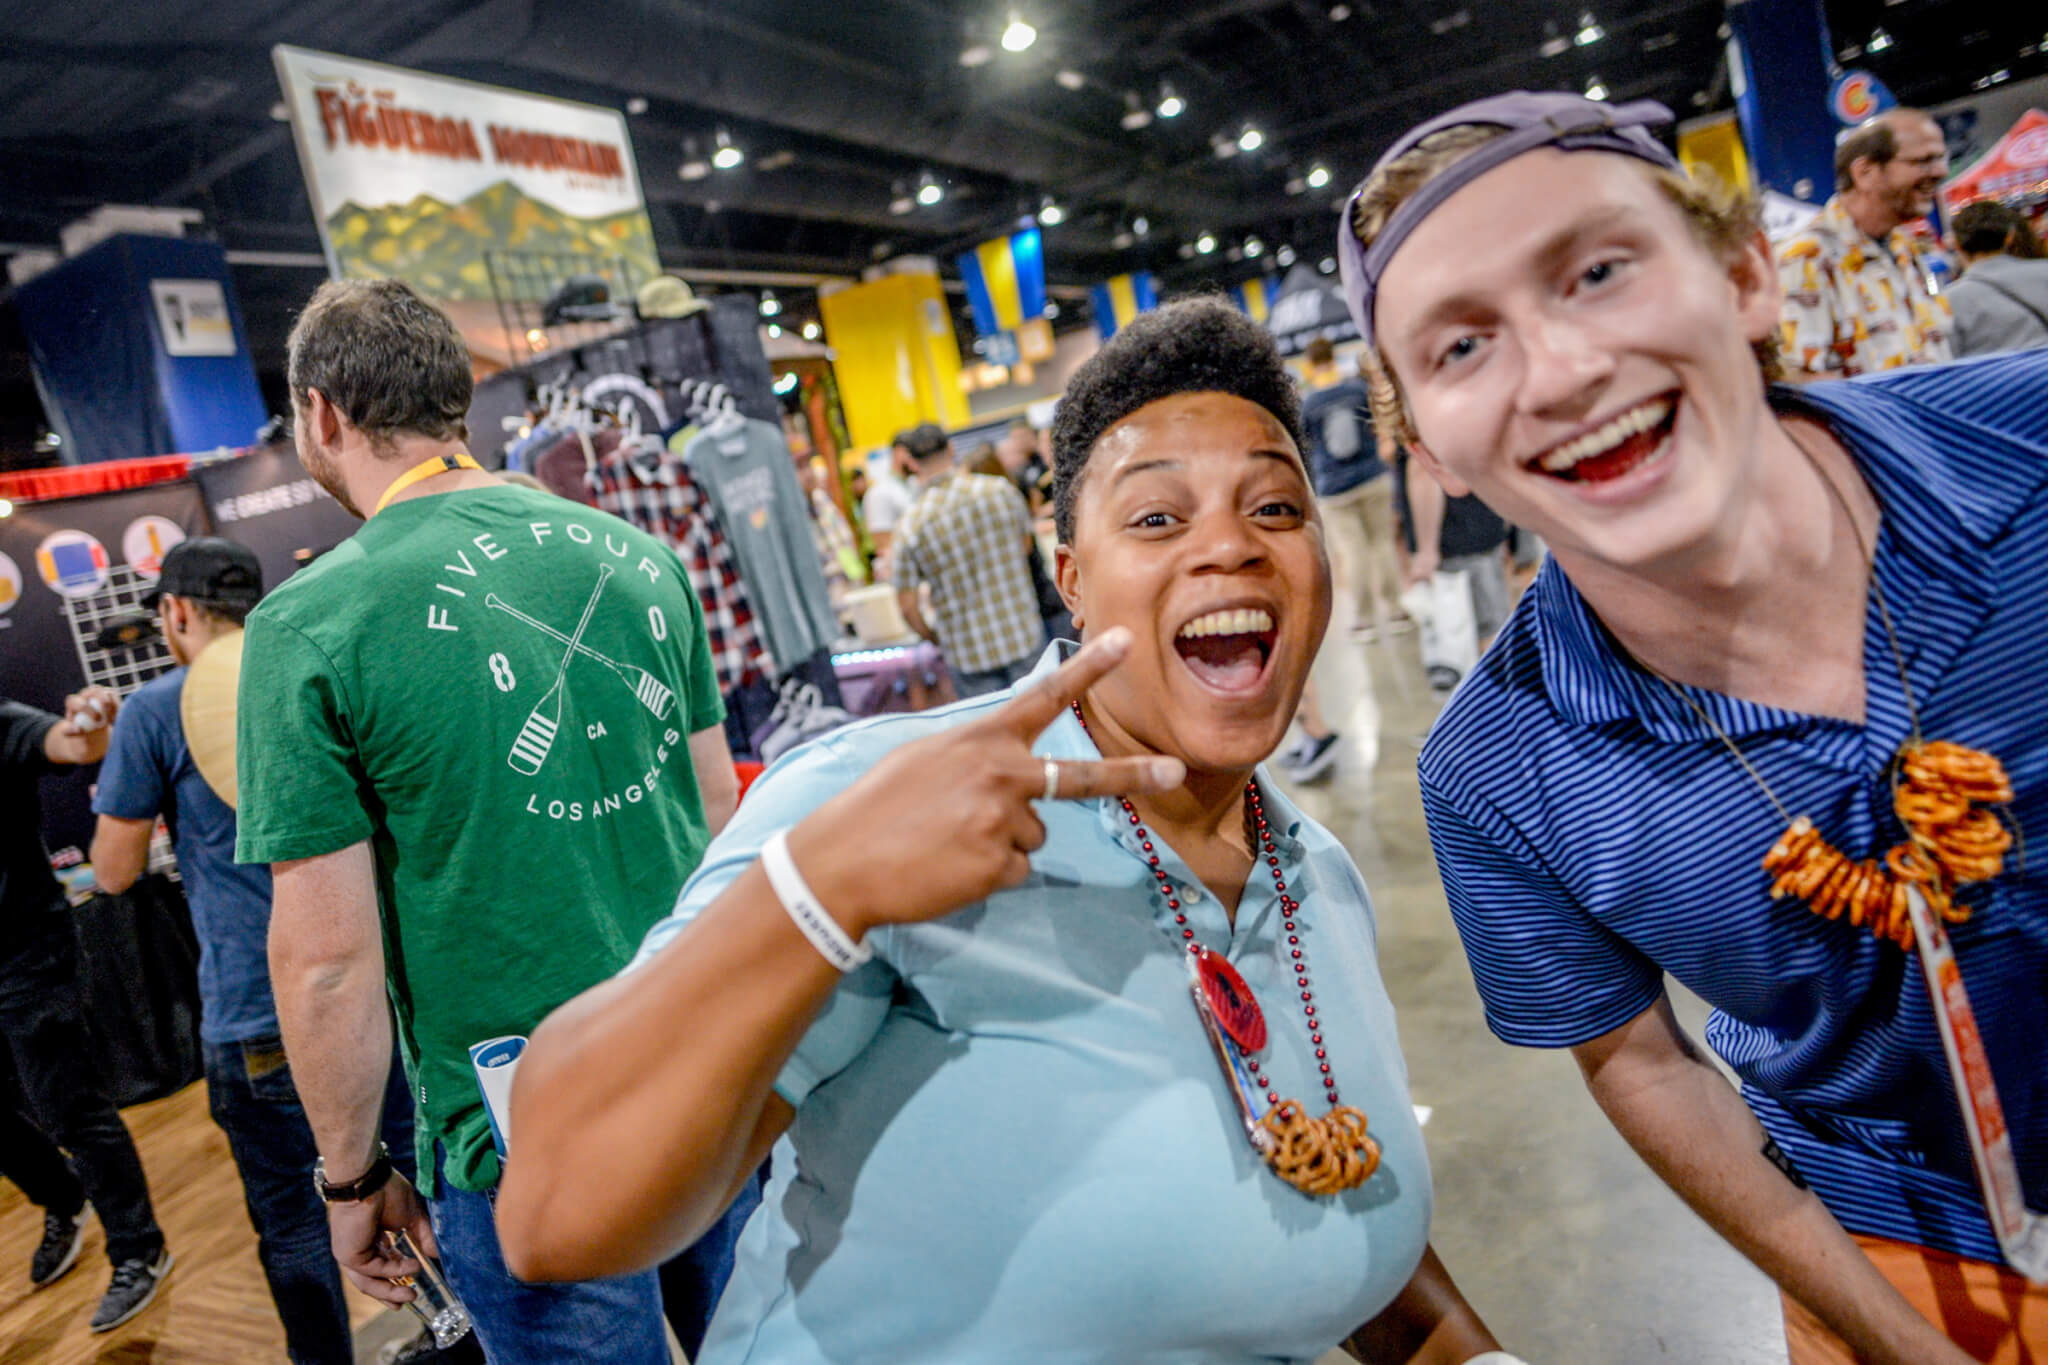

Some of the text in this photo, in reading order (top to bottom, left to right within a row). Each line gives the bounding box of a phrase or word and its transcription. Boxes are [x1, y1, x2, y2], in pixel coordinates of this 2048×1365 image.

[487, 122, 625, 179] MOUNTAIN
[427, 522, 661, 632] FIVE FOUR
[487, 652, 517, 693] 8
[586, 721, 607, 741] CA
[526, 727, 680, 821] LOS ANGELES
